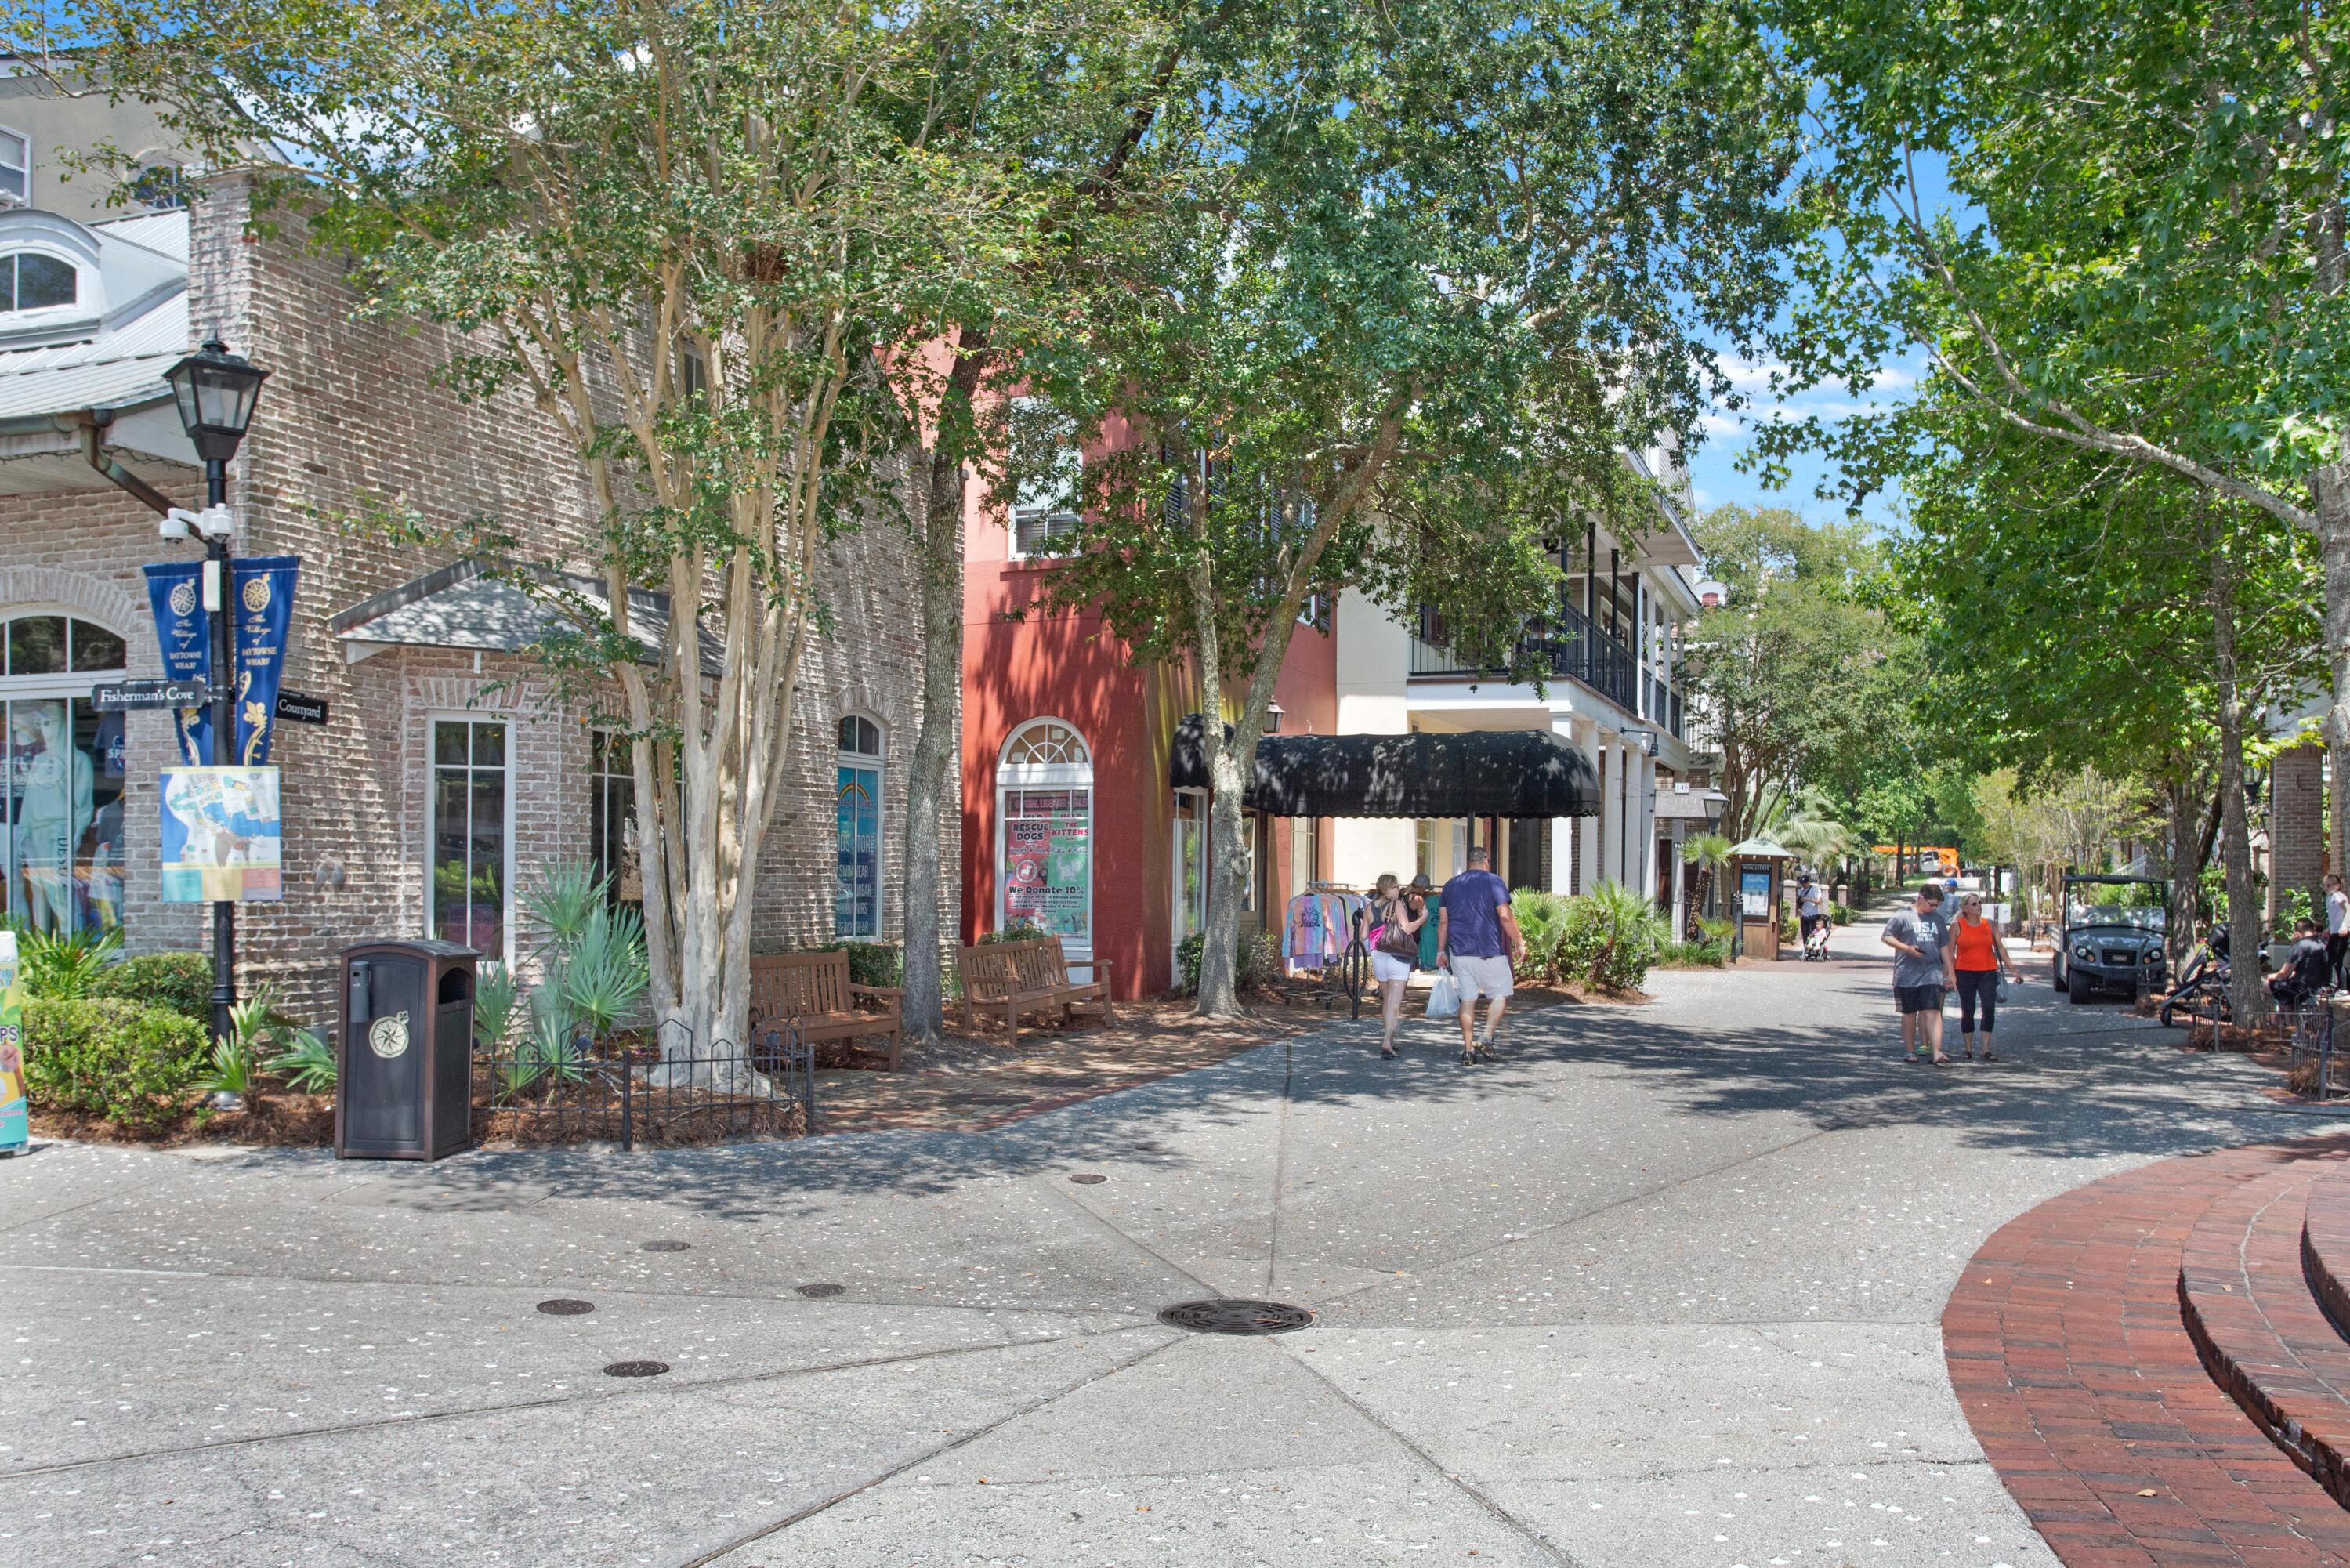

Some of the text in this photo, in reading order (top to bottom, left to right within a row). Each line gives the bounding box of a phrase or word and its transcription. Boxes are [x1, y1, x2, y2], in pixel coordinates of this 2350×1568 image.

[171, 629, 197, 639] Village
[245, 625, 271, 636] Village
[179, 639, 192, 650] of
[252, 636, 263, 645] of
[169, 651, 202, 660] BAYTOWNE
[242, 646, 277, 656] BAYTOWNE
[100, 686, 194, 703] Fisherman's Cove
[278, 698, 321, 720] Courtyard
[838, 832, 851, 852] IDS
[1017, 832, 1044, 841] DOGS
[838, 903, 867, 915] SOUVNIRS
[1912, 922, 1939, 935] USA
